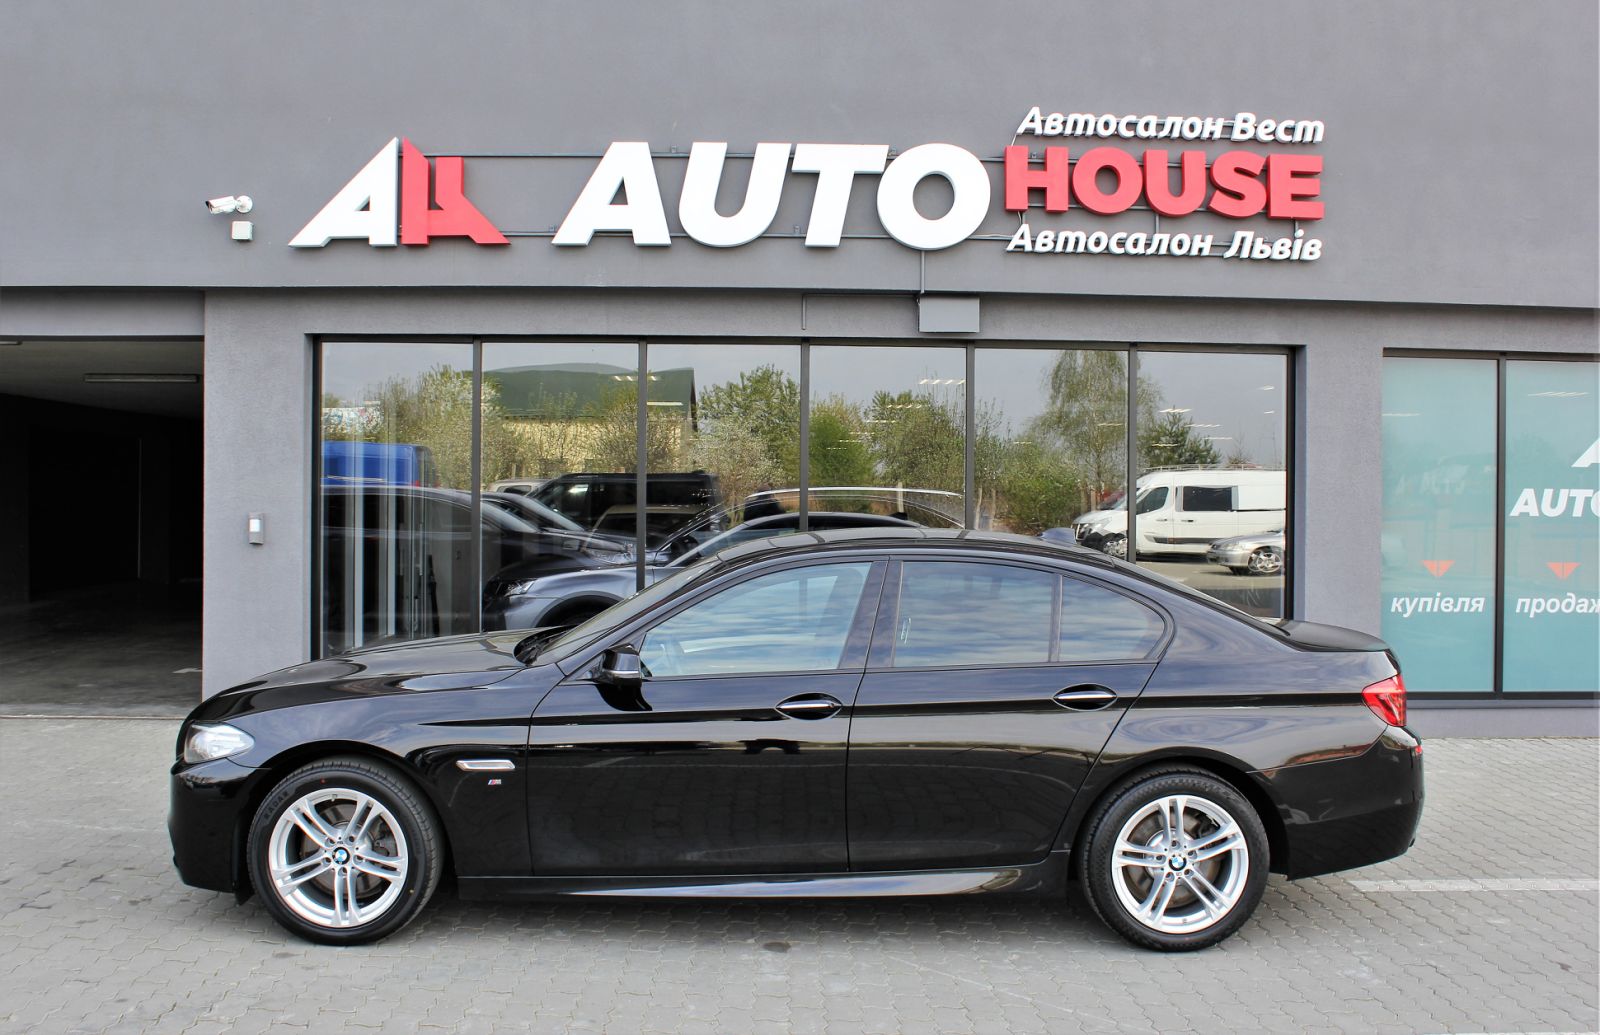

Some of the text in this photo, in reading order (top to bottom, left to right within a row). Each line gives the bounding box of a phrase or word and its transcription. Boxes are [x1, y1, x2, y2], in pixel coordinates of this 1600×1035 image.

[1017, 106, 1325, 143] Автосалон Вест
[551, 141, 991, 251] AUTO
[1004, 145, 1324, 220] HOUSE
[1006, 223, 1323, 261] Автосалон Львів
[1390, 592, 1485, 618] купівля
